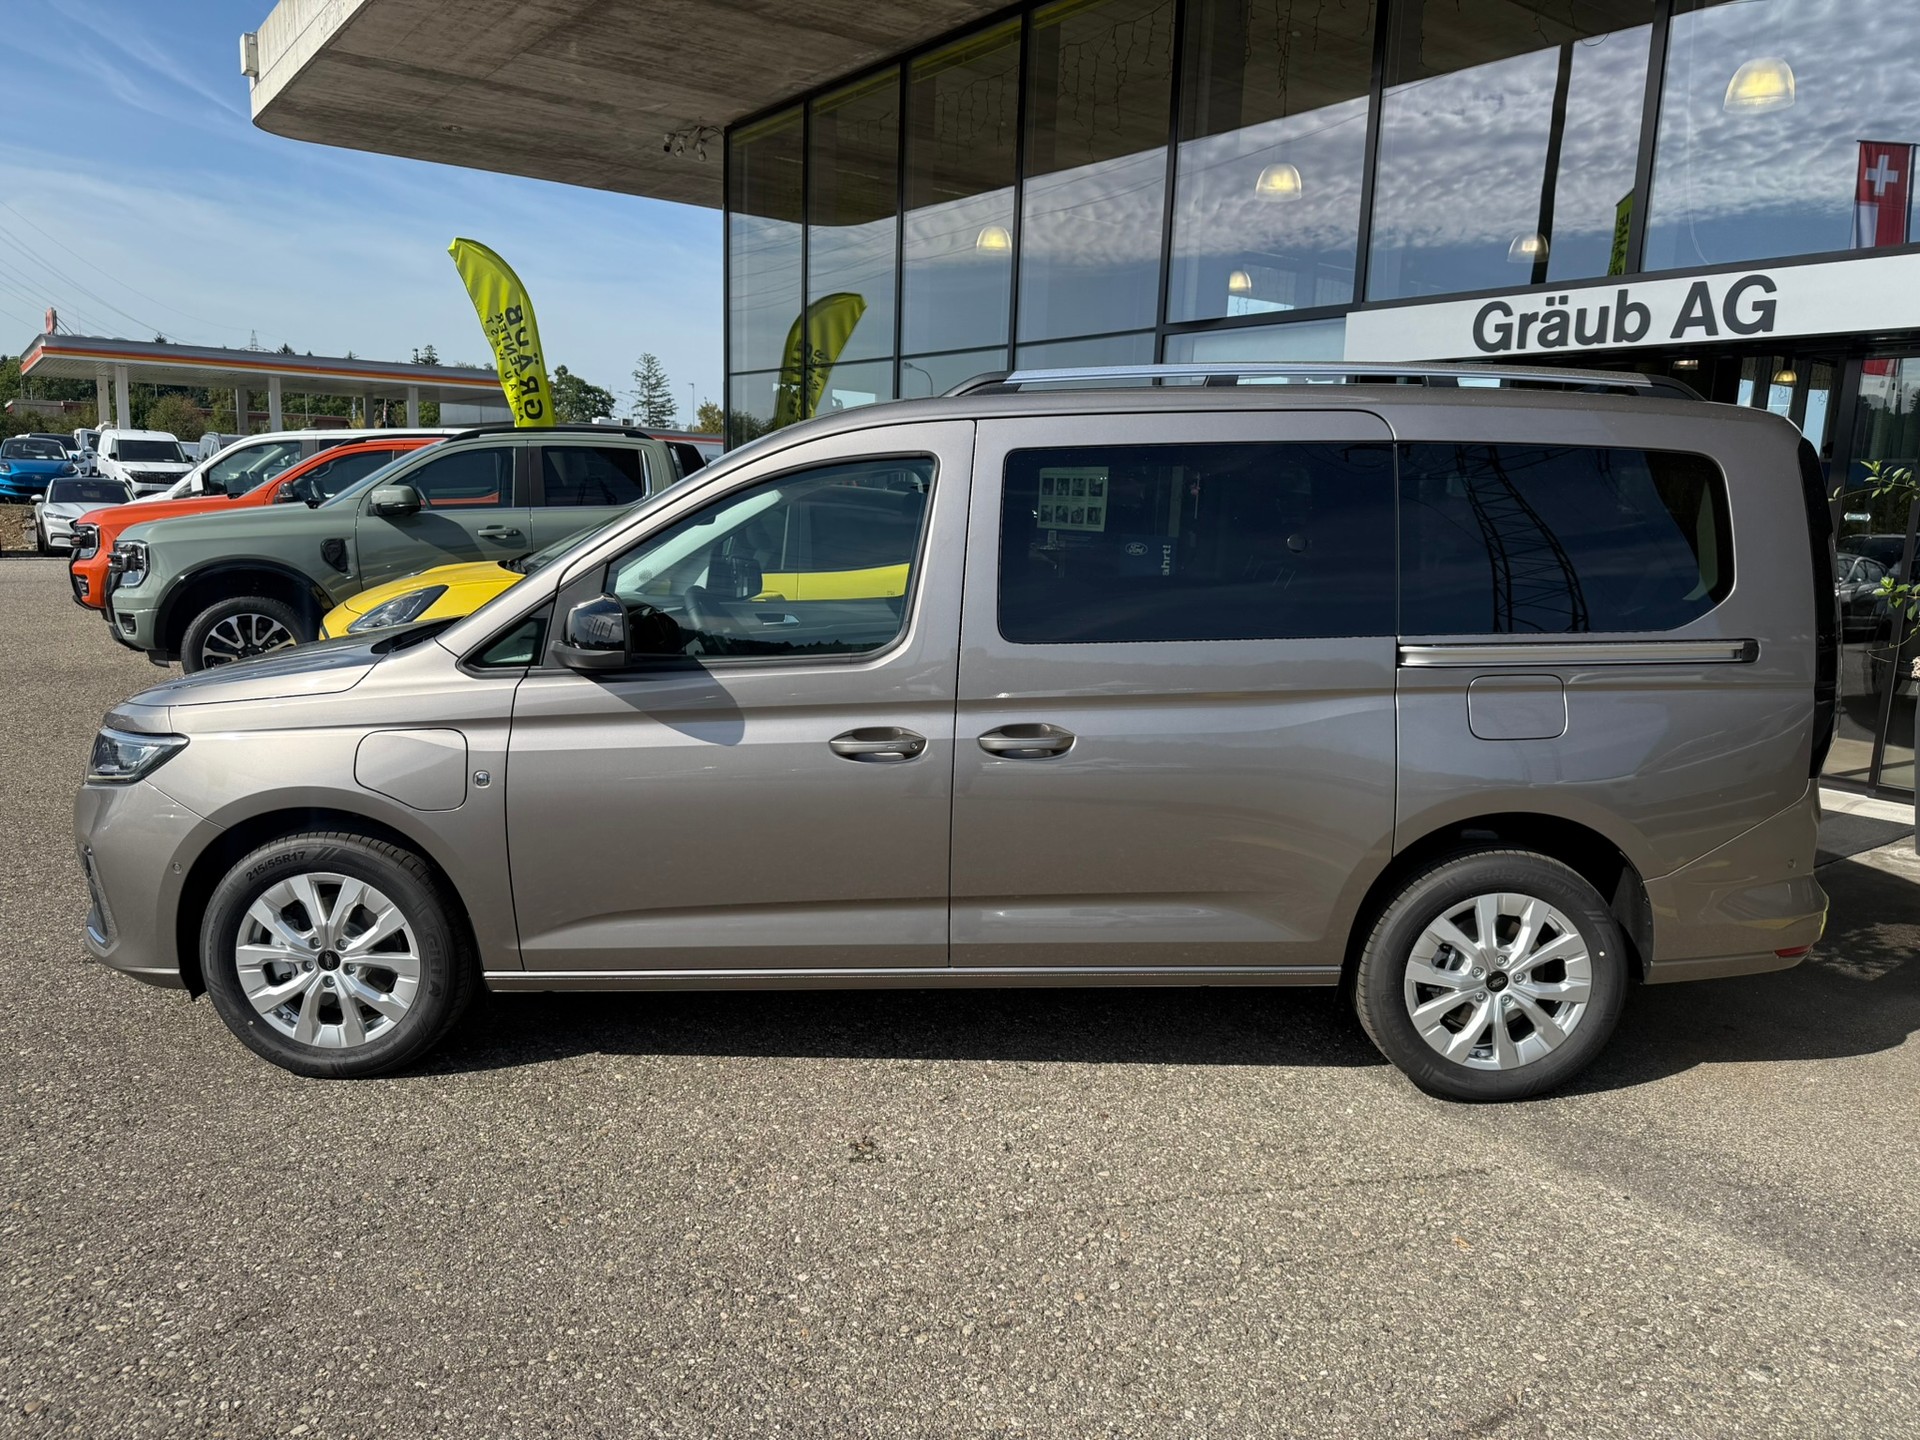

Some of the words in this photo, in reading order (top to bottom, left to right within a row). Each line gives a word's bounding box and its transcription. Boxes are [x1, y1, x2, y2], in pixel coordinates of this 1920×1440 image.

[1472, 288, 1651, 353] Gräub
[1670, 274, 1777, 338] AG
[245, 851, 306, 882] 215/55R17
